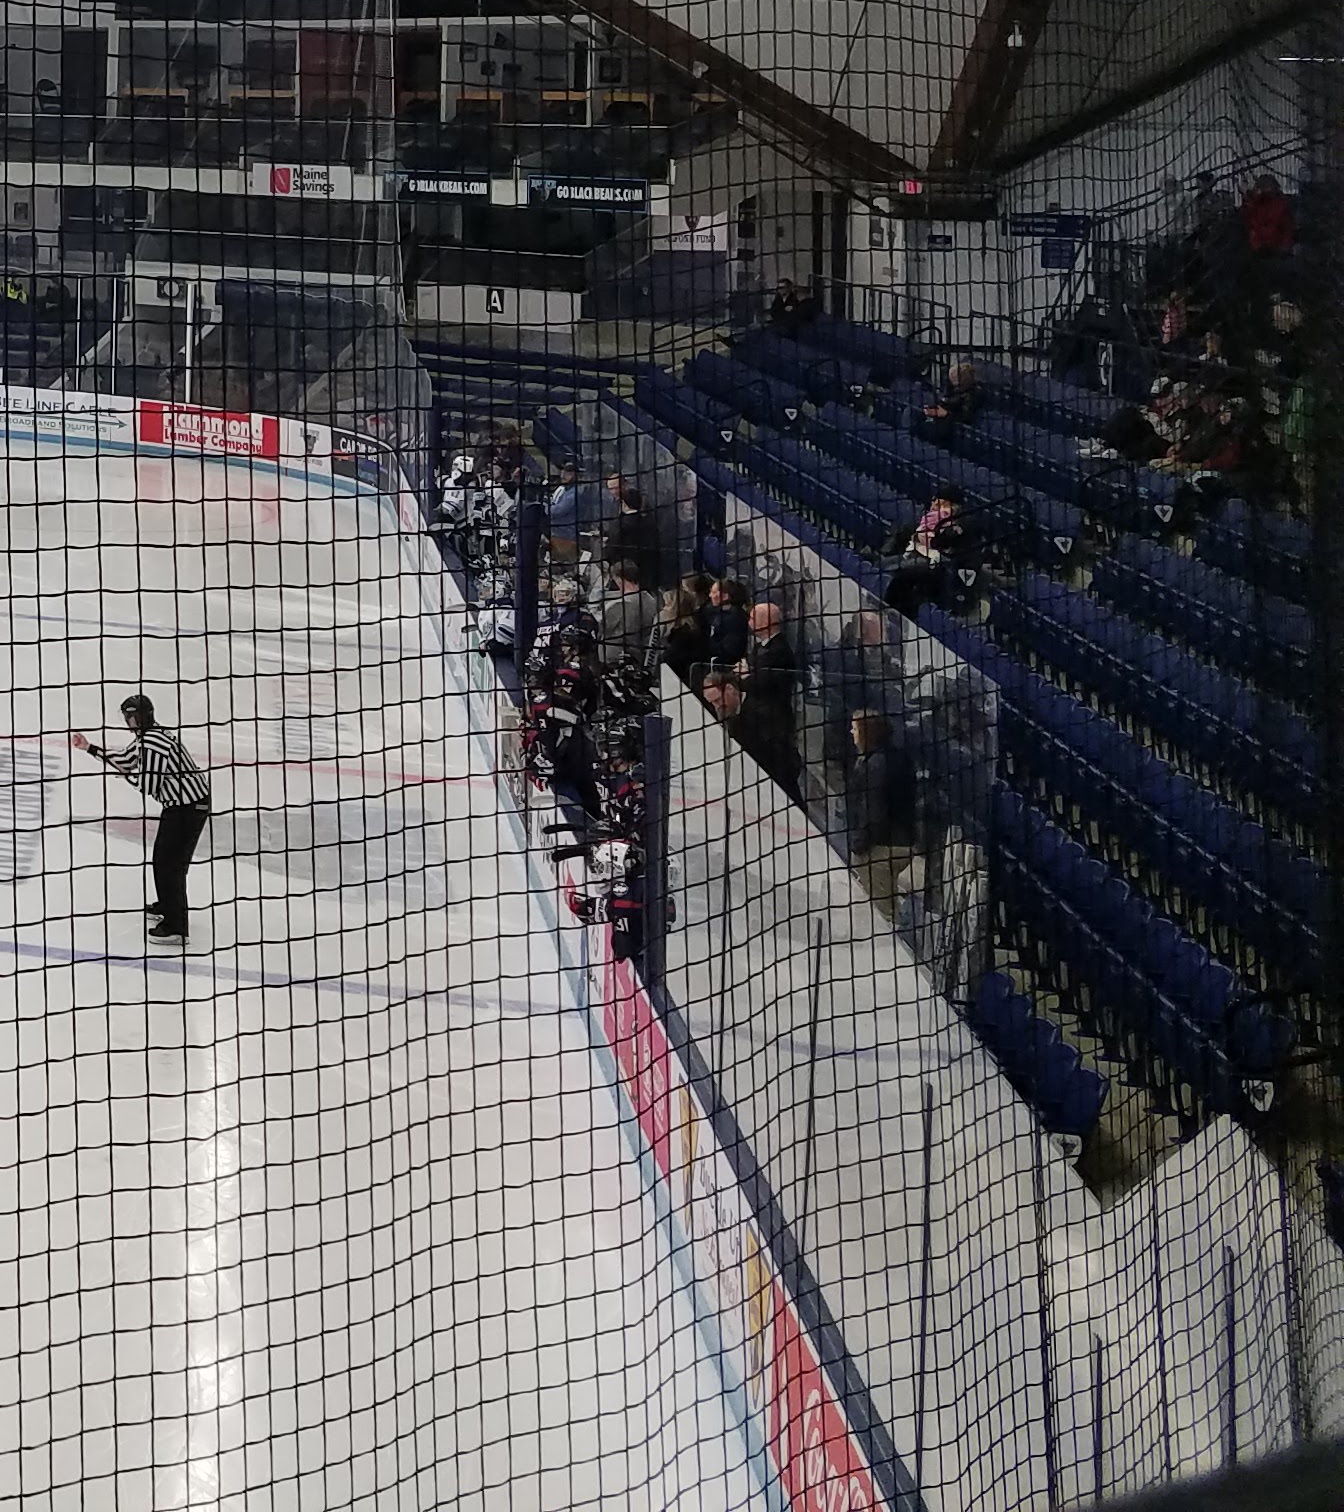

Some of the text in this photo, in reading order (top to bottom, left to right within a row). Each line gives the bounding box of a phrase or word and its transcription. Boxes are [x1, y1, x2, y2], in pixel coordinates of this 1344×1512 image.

[293, 167, 329, 181] Maine
[293, 181, 335, 195] Savings
[489, 290, 503, 311] A
[164, 428, 263, 455] Lumber Company
